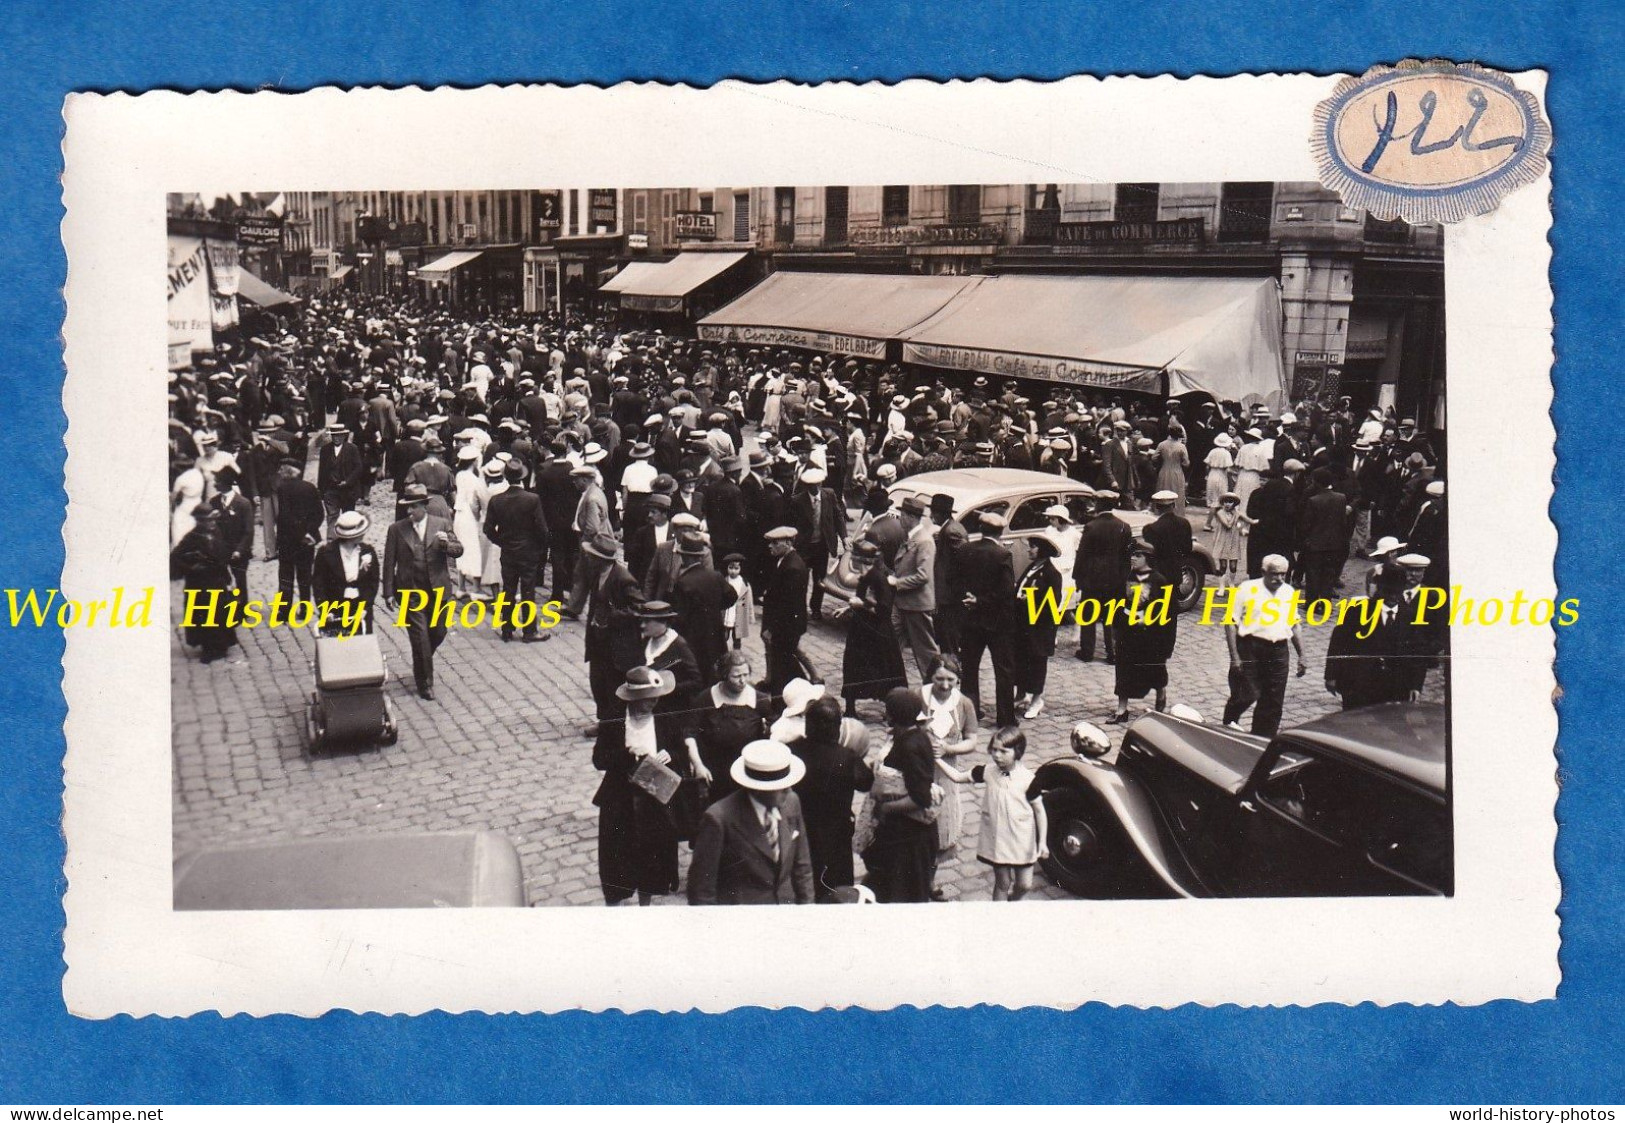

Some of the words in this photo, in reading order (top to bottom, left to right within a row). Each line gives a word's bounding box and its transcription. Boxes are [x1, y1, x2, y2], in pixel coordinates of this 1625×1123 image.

[678, 215, 715, 227] HOTEL
[240, 226, 281, 237] GAULOIS
[1111, 221, 1198, 240] COMMERCE
